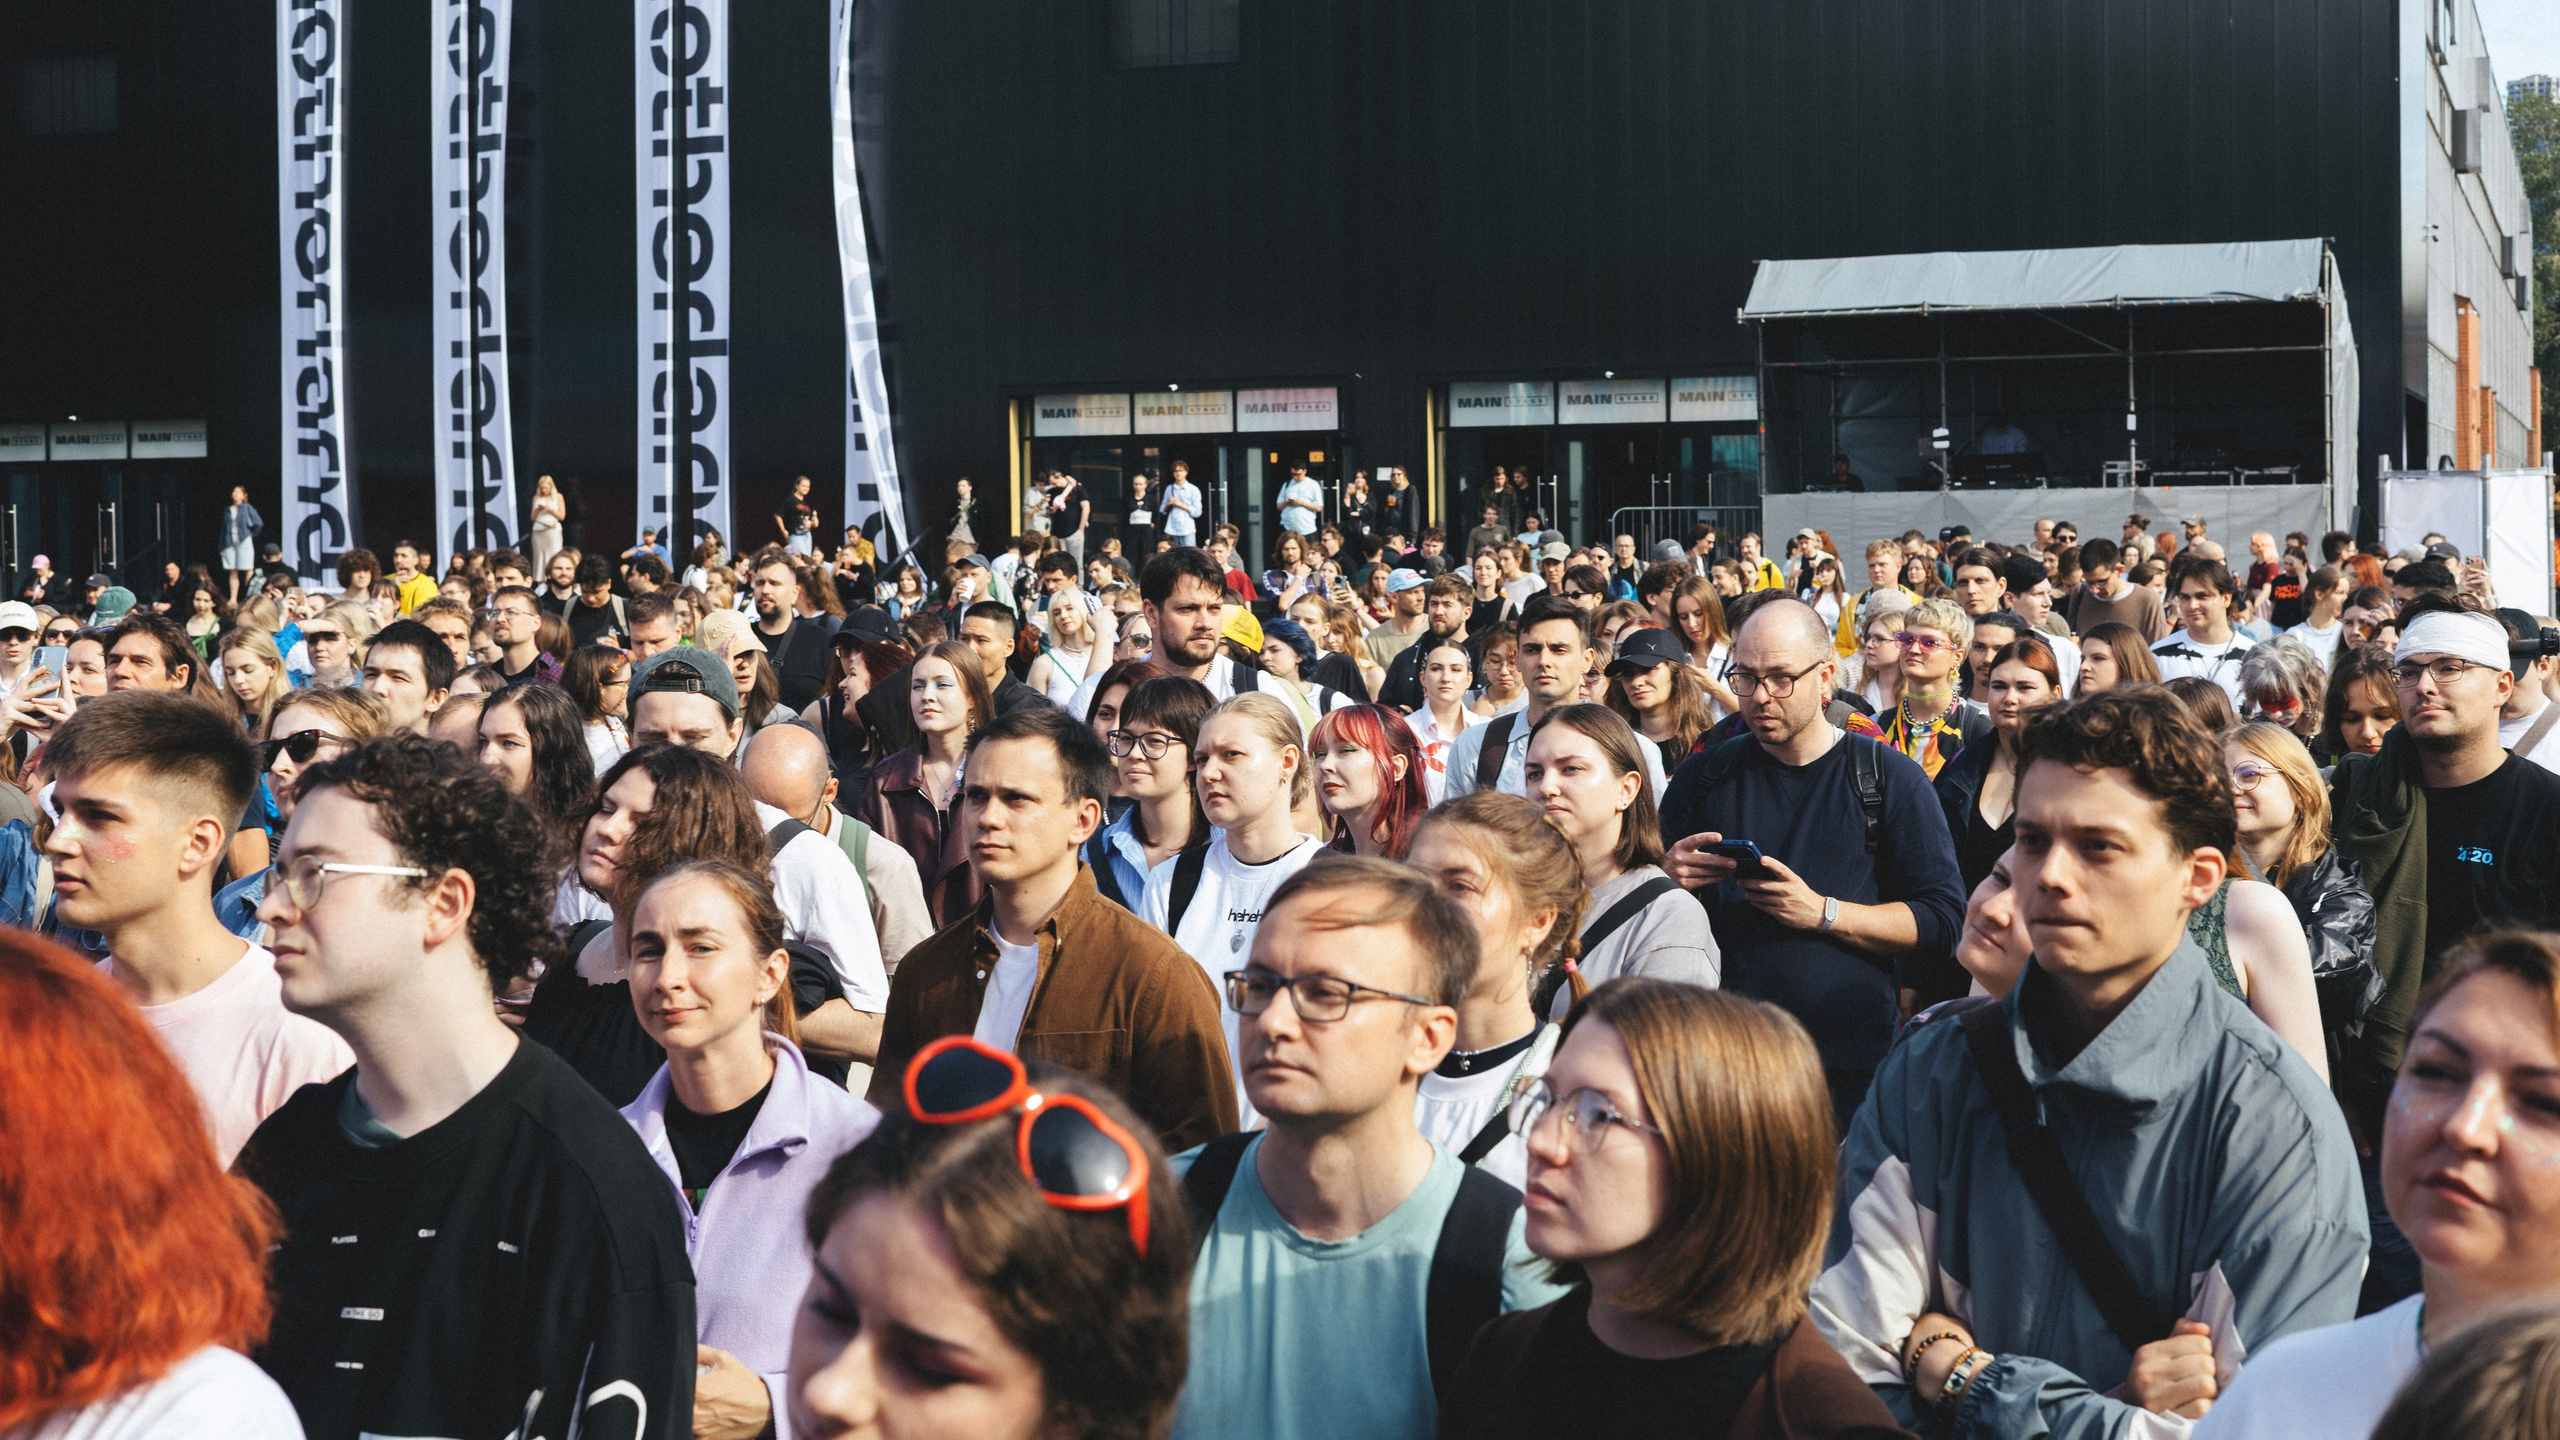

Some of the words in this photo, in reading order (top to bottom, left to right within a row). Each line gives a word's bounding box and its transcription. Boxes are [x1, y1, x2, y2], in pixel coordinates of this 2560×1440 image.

[1567, 394, 1612, 405] MAIN
[1679, 391, 1724, 402] MAIN
[1457, 397, 1502, 408] MAIN
[1042, 408, 1083, 418] MAIN
[1142, 405, 1183, 416] MAIN
[1245, 403, 1287, 414] MAIN
[55, 435, 91, 445] MAIN
[137, 433, 172, 443] MAIN
